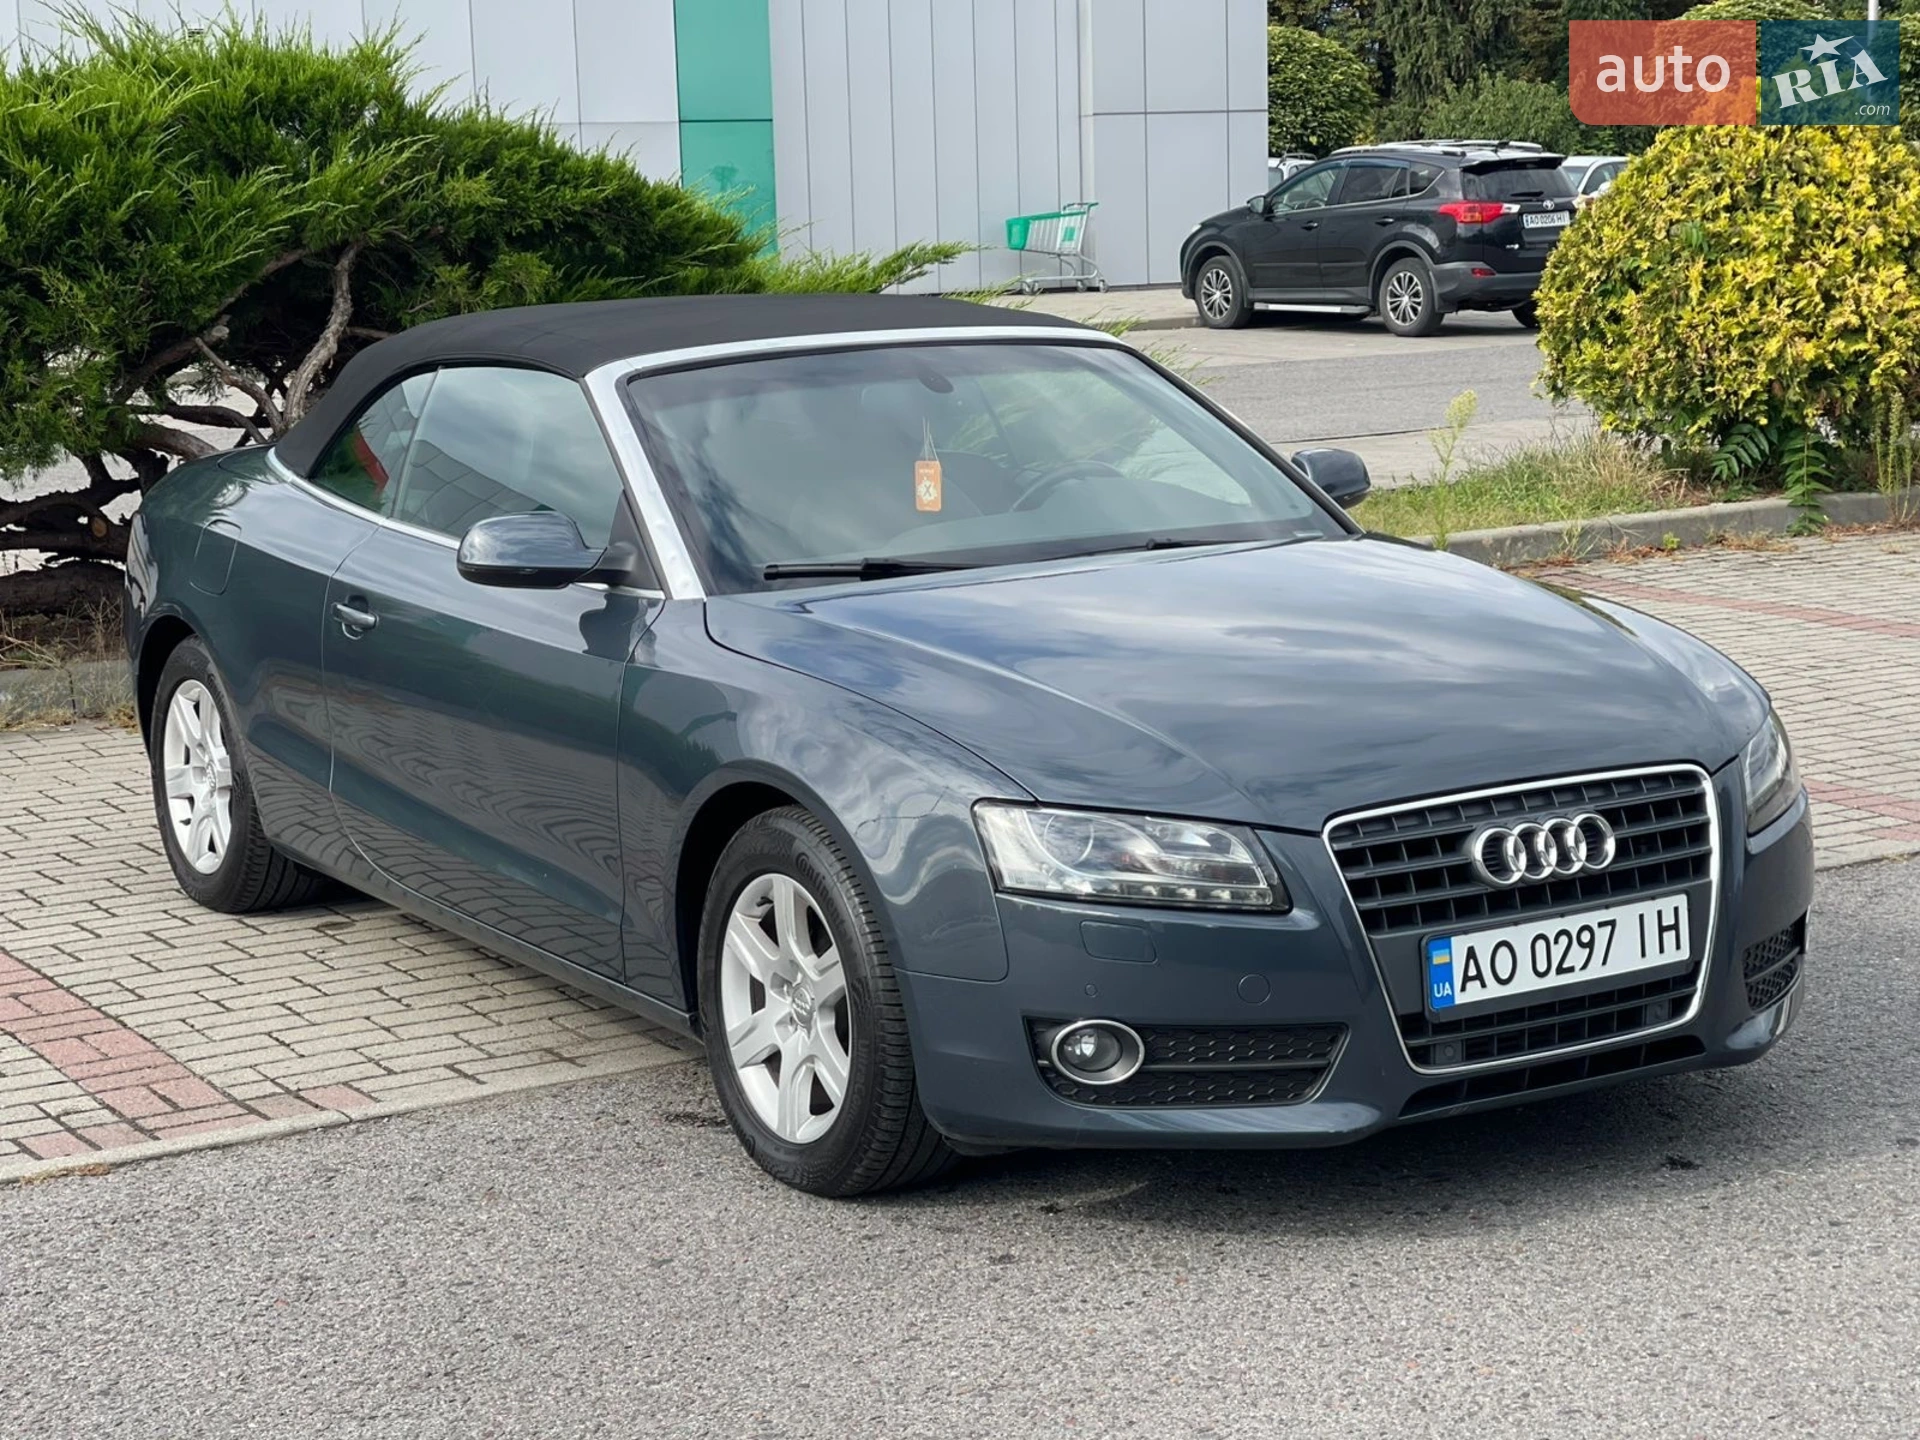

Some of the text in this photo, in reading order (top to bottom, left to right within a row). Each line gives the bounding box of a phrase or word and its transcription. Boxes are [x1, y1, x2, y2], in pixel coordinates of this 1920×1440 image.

[1460, 905, 1682, 993] AO 0297 IH
[1433, 984, 1452, 998] UA
